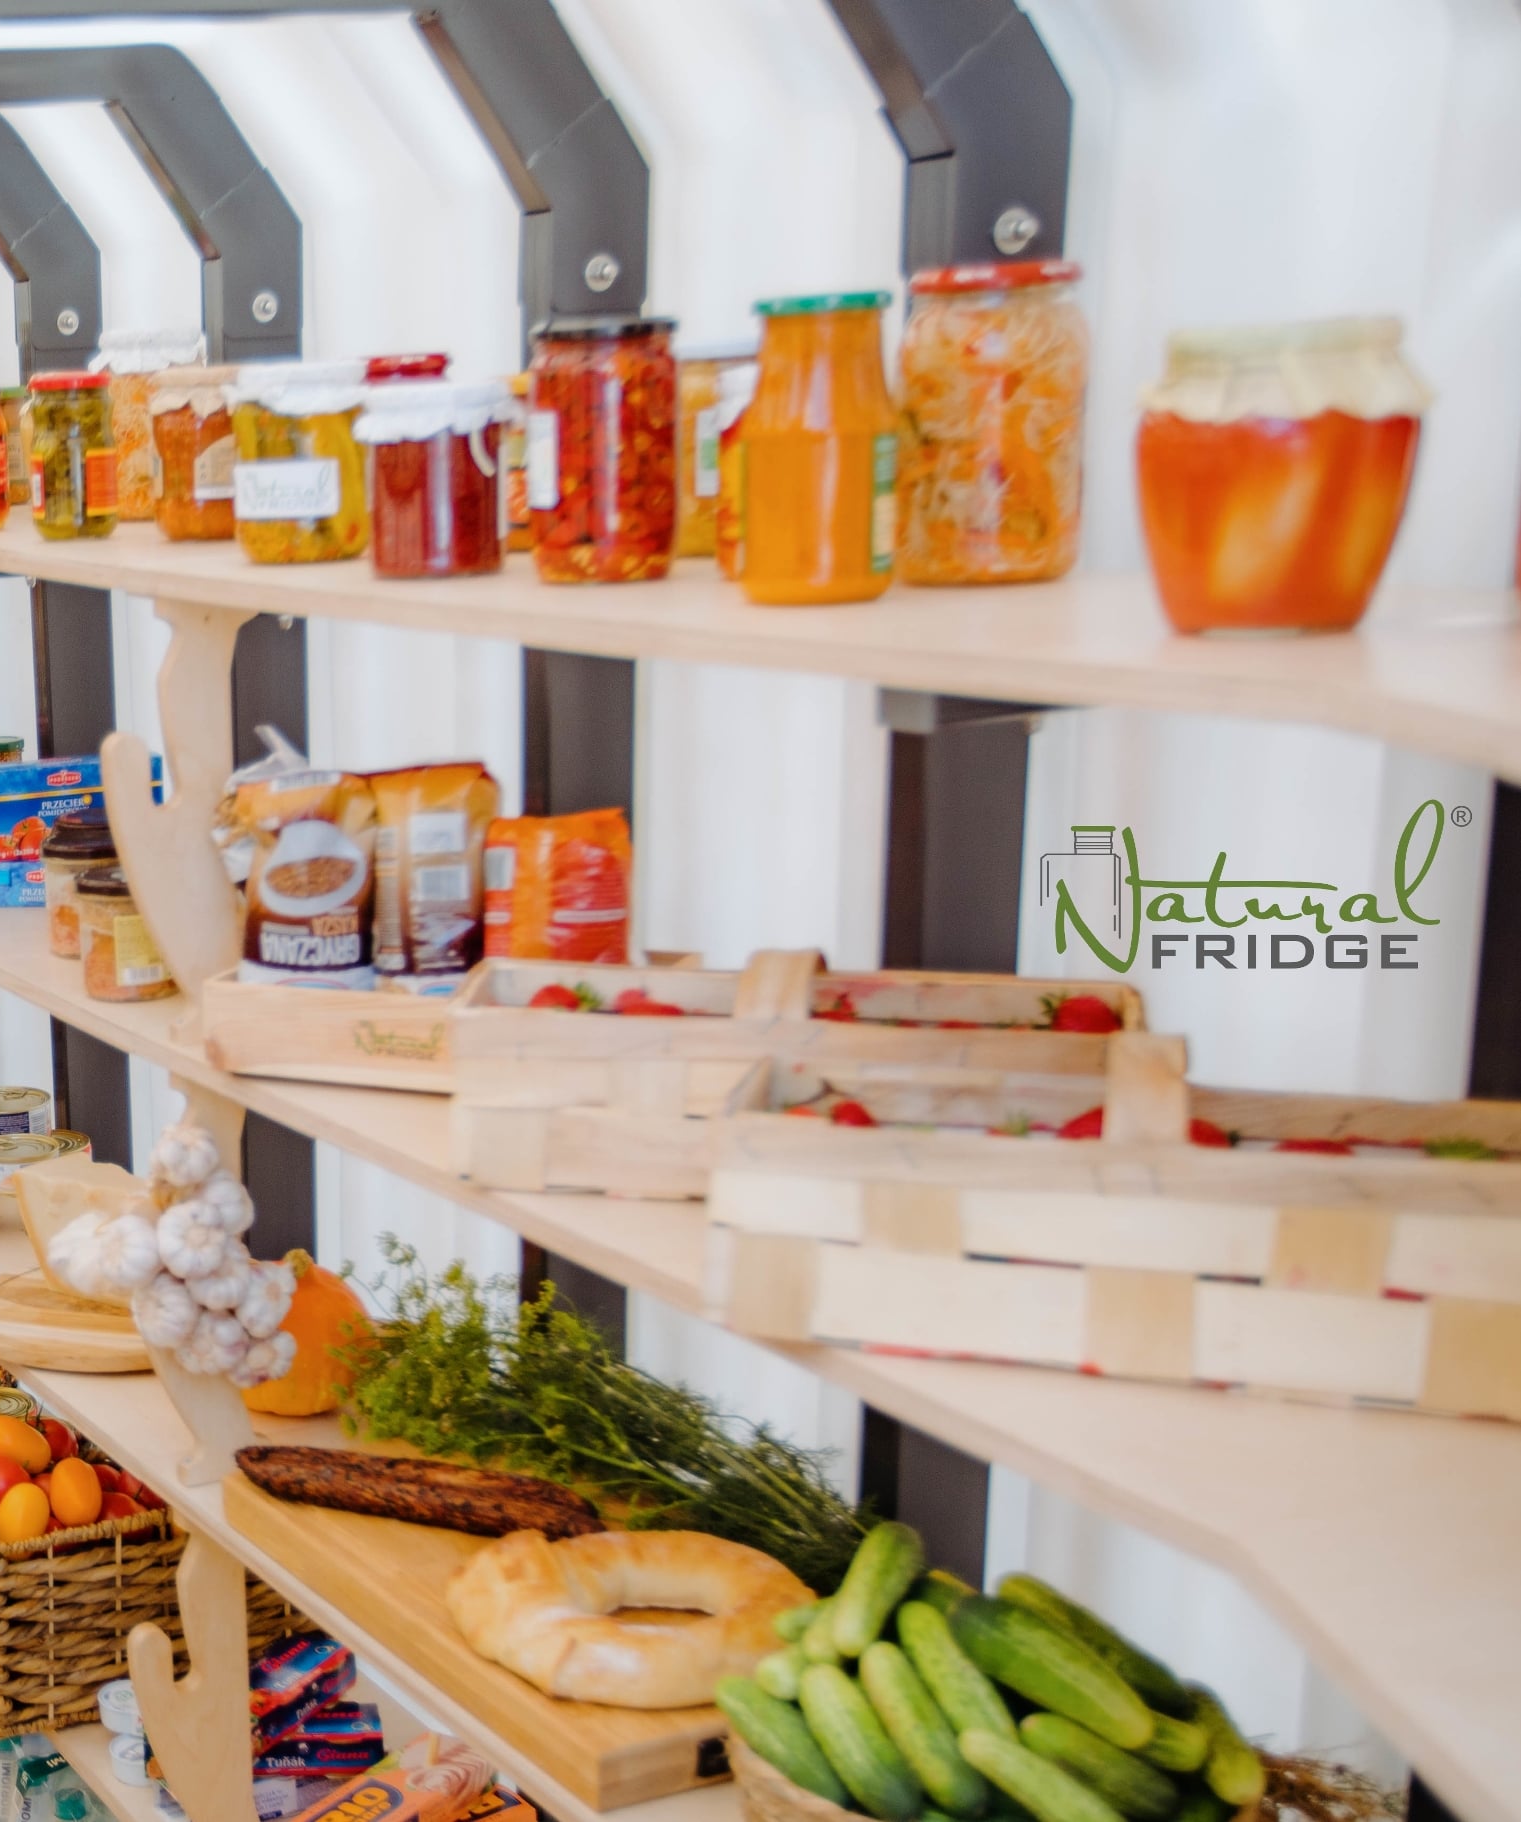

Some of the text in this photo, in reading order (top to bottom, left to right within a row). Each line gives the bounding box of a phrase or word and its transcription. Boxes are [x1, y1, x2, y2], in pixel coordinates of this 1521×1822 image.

[42, 798, 85, 811] PRZECIER
[261, 933, 361, 966] GRYCZANA
[265, 1747, 370, 1769] Tuňák Giana
